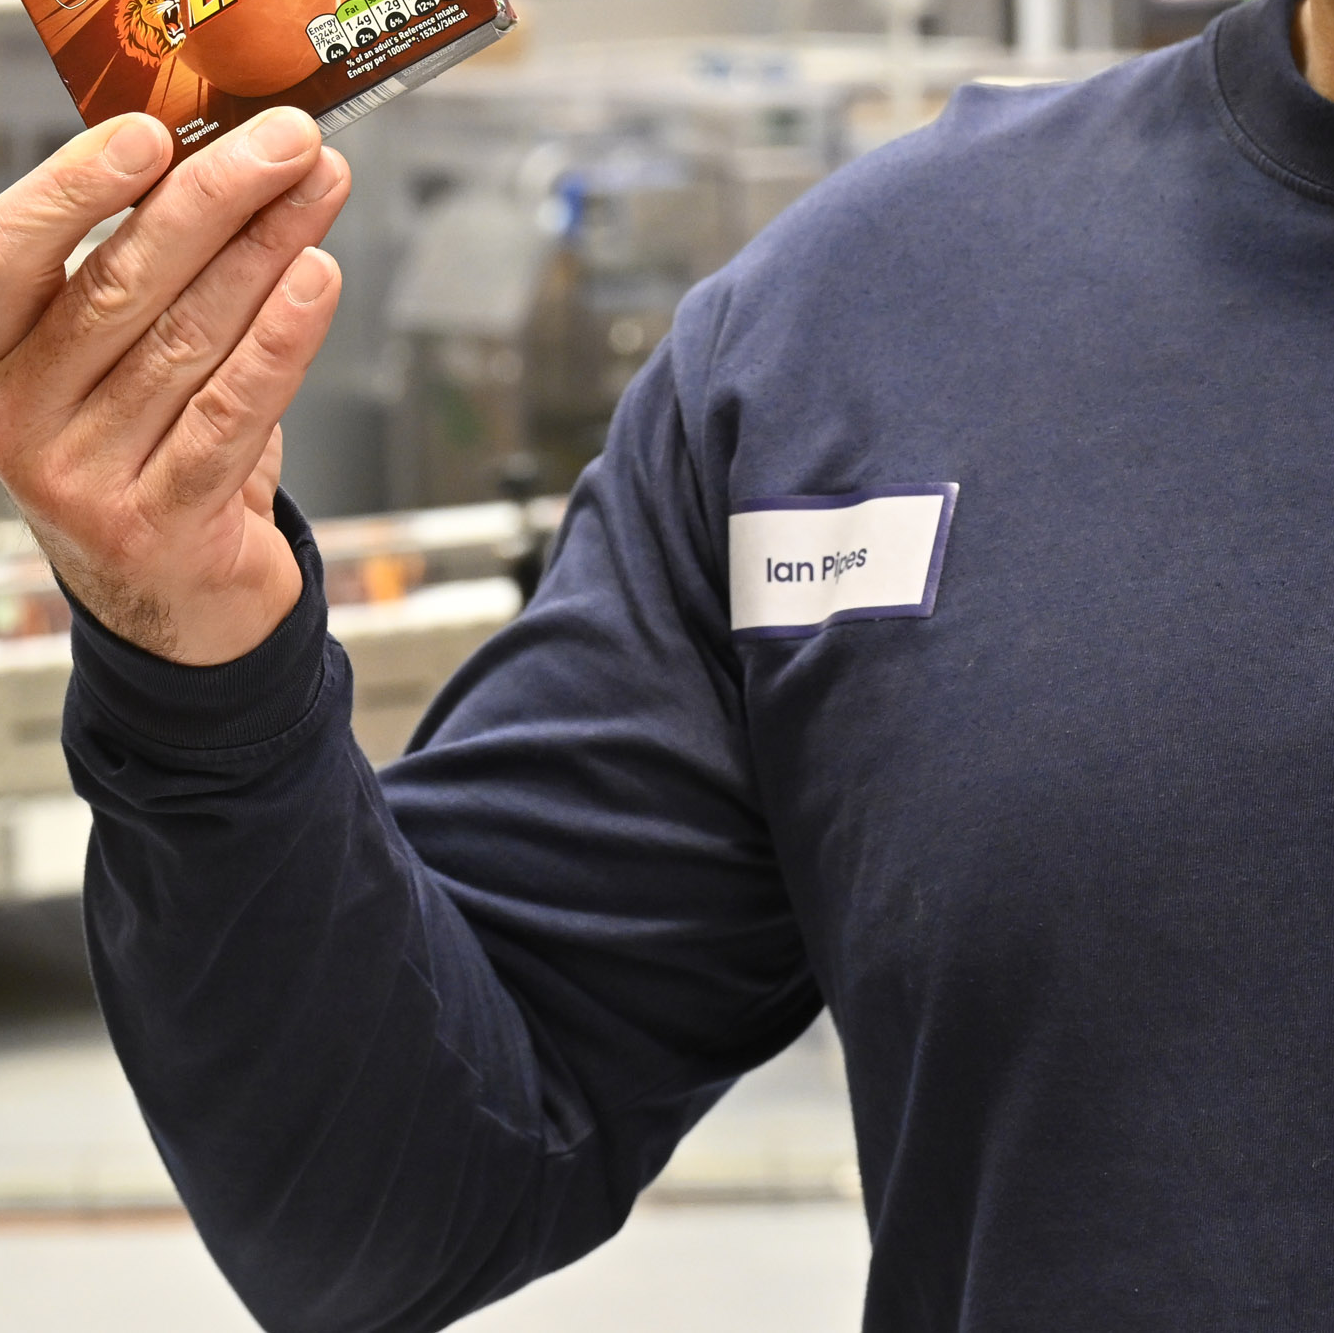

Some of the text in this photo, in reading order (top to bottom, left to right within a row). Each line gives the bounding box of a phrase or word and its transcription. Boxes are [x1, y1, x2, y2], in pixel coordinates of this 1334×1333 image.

[345, 5, 359, 16] Fat
[416, 0, 435, 13] 12%
[307, 17, 337, 36] Energy
[345, 14, 372, 32] 1.4g
[390, 18, 403, 27] 6%
[315, 32, 345, 50] 77kcal
[346, 58, 356, 68] %
[355, 53, 366, 64] of
[374, 35, 399, 54] adult's
[398, 16, 436, 41] Reference
[434, 3, 460, 21] Intake
[347, 61, 375, 79] Energy
[374, 53, 387, 67] per
[419, 9, 469, 40] 152kJ/36kcal
[359, 34, 373, 44] 2%
[331, 49, 344, 59] 4%
[175, 117, 205, 136] Serving
[181, 121, 220, 146] suggestion
[766, 557, 815, 583] Ian
